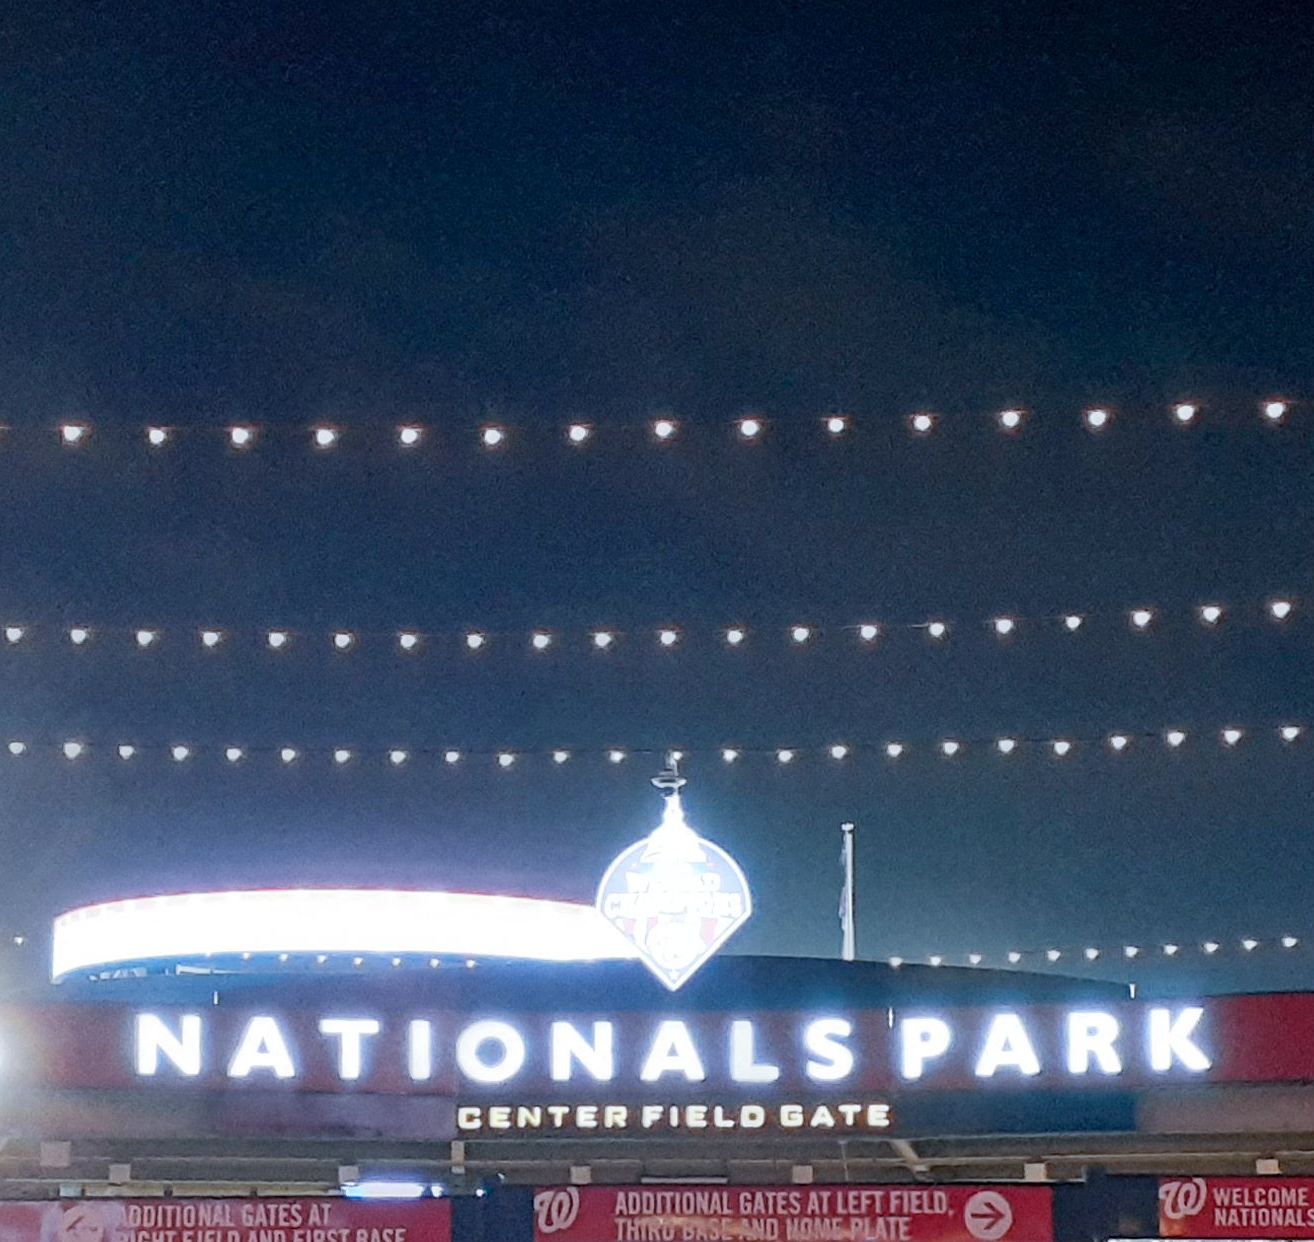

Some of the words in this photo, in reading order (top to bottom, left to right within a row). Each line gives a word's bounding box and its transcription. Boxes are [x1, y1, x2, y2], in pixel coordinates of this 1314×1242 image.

[134, 1013, 855, 1083] NATIONALS
[900, 1006, 1213, 1080] PARK
[457, 1106, 627, 1130] CENTER
[642, 1105, 766, 1130] FIELD
[780, 1104, 891, 1128] GATE
[614, 1192, 733, 1214] ADDITIONAL
[739, 1191, 801, 1214] GATES
[807, 1191, 832, 1214] AT
[837, 1191, 884, 1213] LEFT
[889, 1190, 955, 1218] FIELD,
[1213, 1187, 1313, 1207] WELCOME
[115, 1205, 234, 1228] ADDITIONAL
[242, 1204, 302, 1228] GATES
[308, 1204, 333, 1227] AT
[614, 1217, 676, 1242] THIRD
[683, 1217, 733, 1241] BASE
[738, 1217, 779, 1241] AND
[786, 1217, 844, 1241] HOME
[850, 1217, 911, 1240] PLATE
